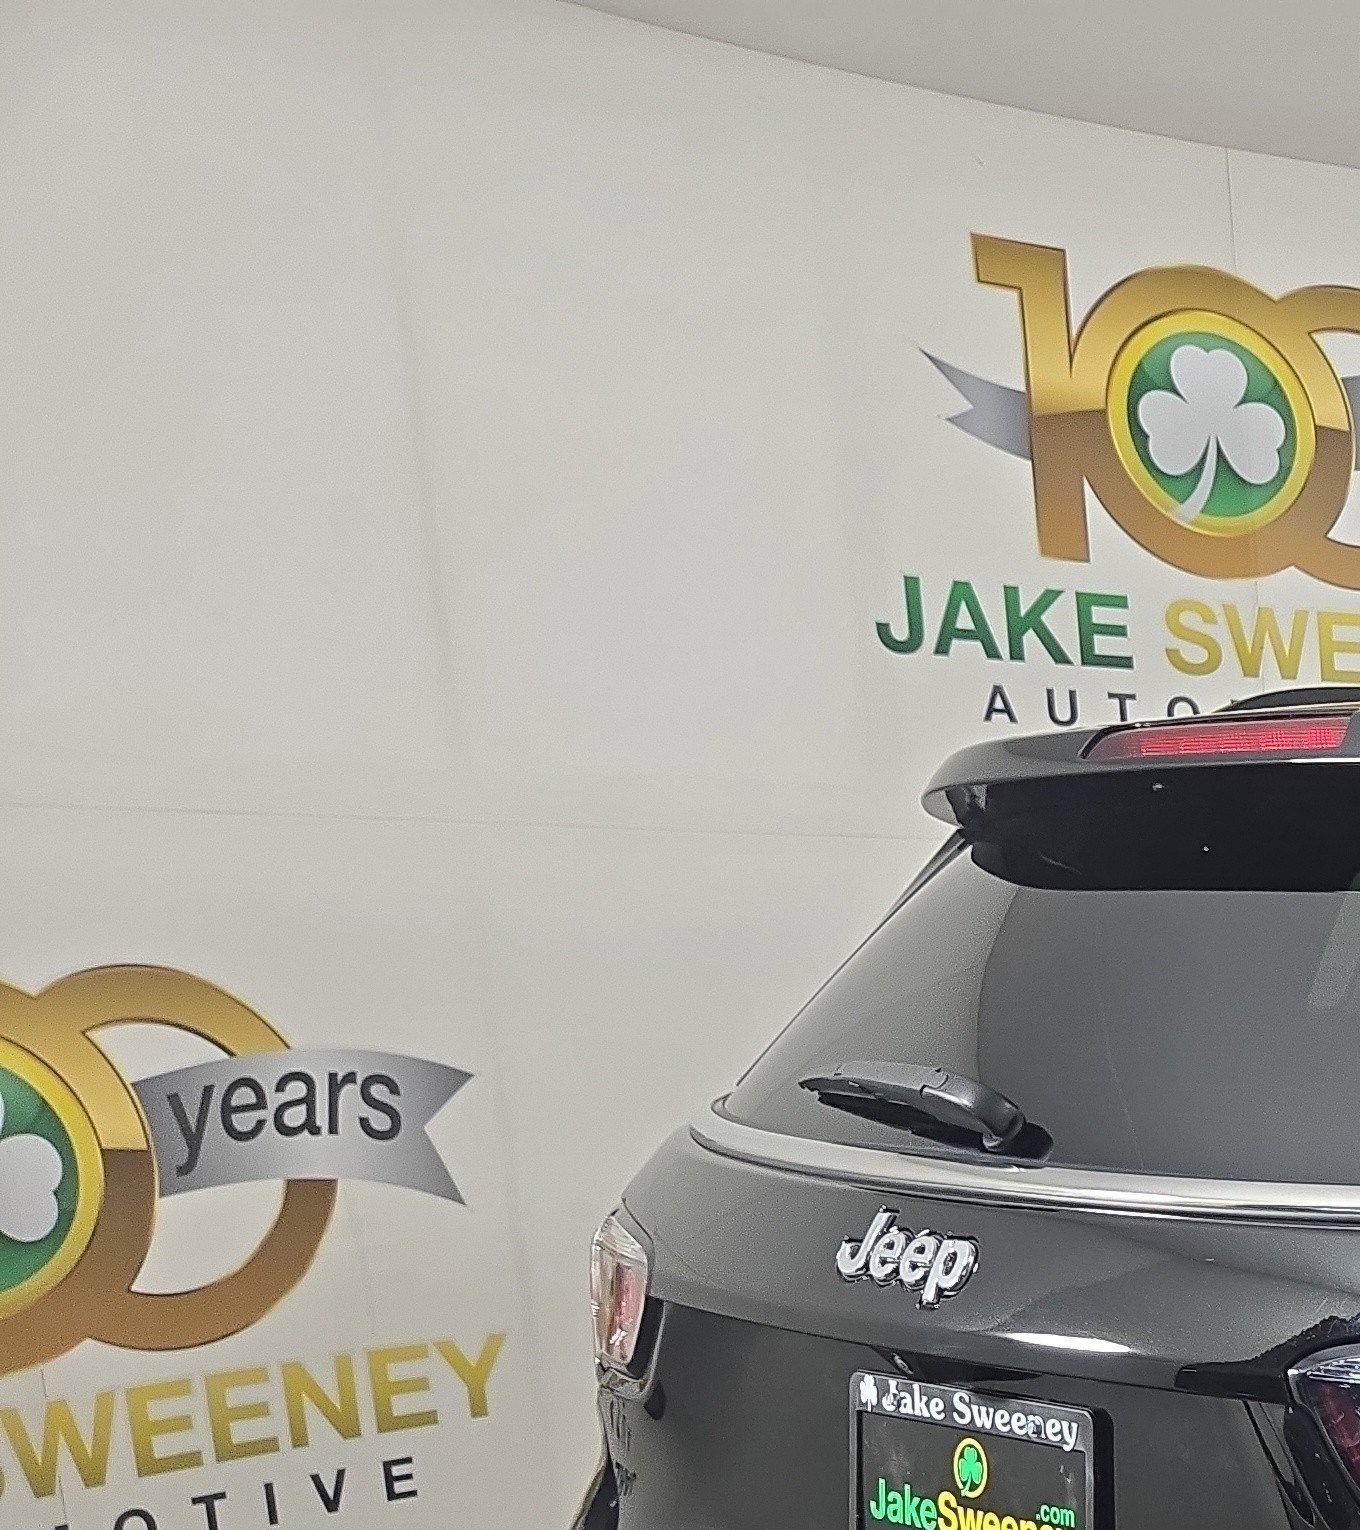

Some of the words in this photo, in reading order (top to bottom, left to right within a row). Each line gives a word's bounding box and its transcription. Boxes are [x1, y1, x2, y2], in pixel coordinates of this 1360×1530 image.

[874, 574, 1134, 670] JAKE
[983, 683, 1239, 726] AUTO
[166, 1070, 402, 1177] years
[836, 1204, 980, 1309] Jeep
[0, 1333, 506, 1500] WEENEY
[882, 1380, 945, 1420] Jake
[953, 1392, 1079, 1451] Sweeney
